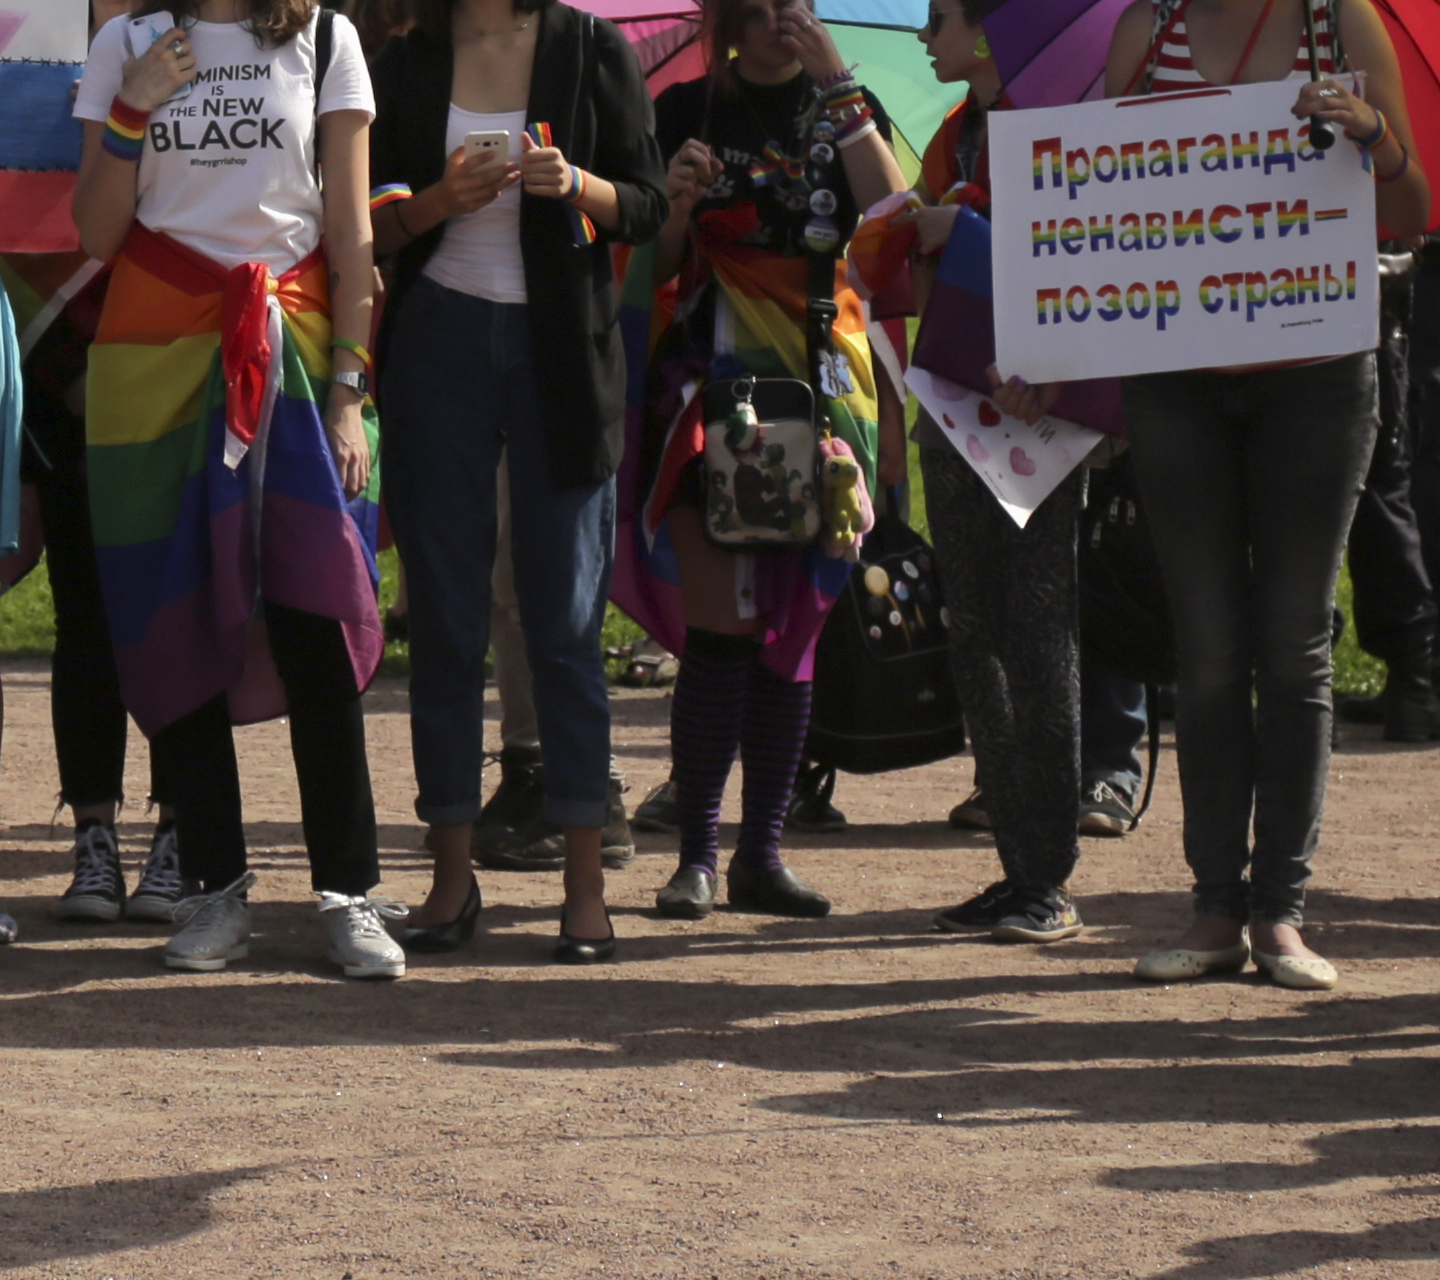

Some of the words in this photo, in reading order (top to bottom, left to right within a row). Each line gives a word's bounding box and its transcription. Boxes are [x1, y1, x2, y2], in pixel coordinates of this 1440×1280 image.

[195, 63, 271, 86] MINISM
[211, 84, 224, 96] IS
[169, 105, 197, 117] THE
[202, 96, 265, 118] NEW
[149, 117, 287, 153] BLACK
[1032, 123, 1326, 200] Пропаганда
[1036, 278, 1181, 331] позор
[1198, 260, 1357, 323] страны
